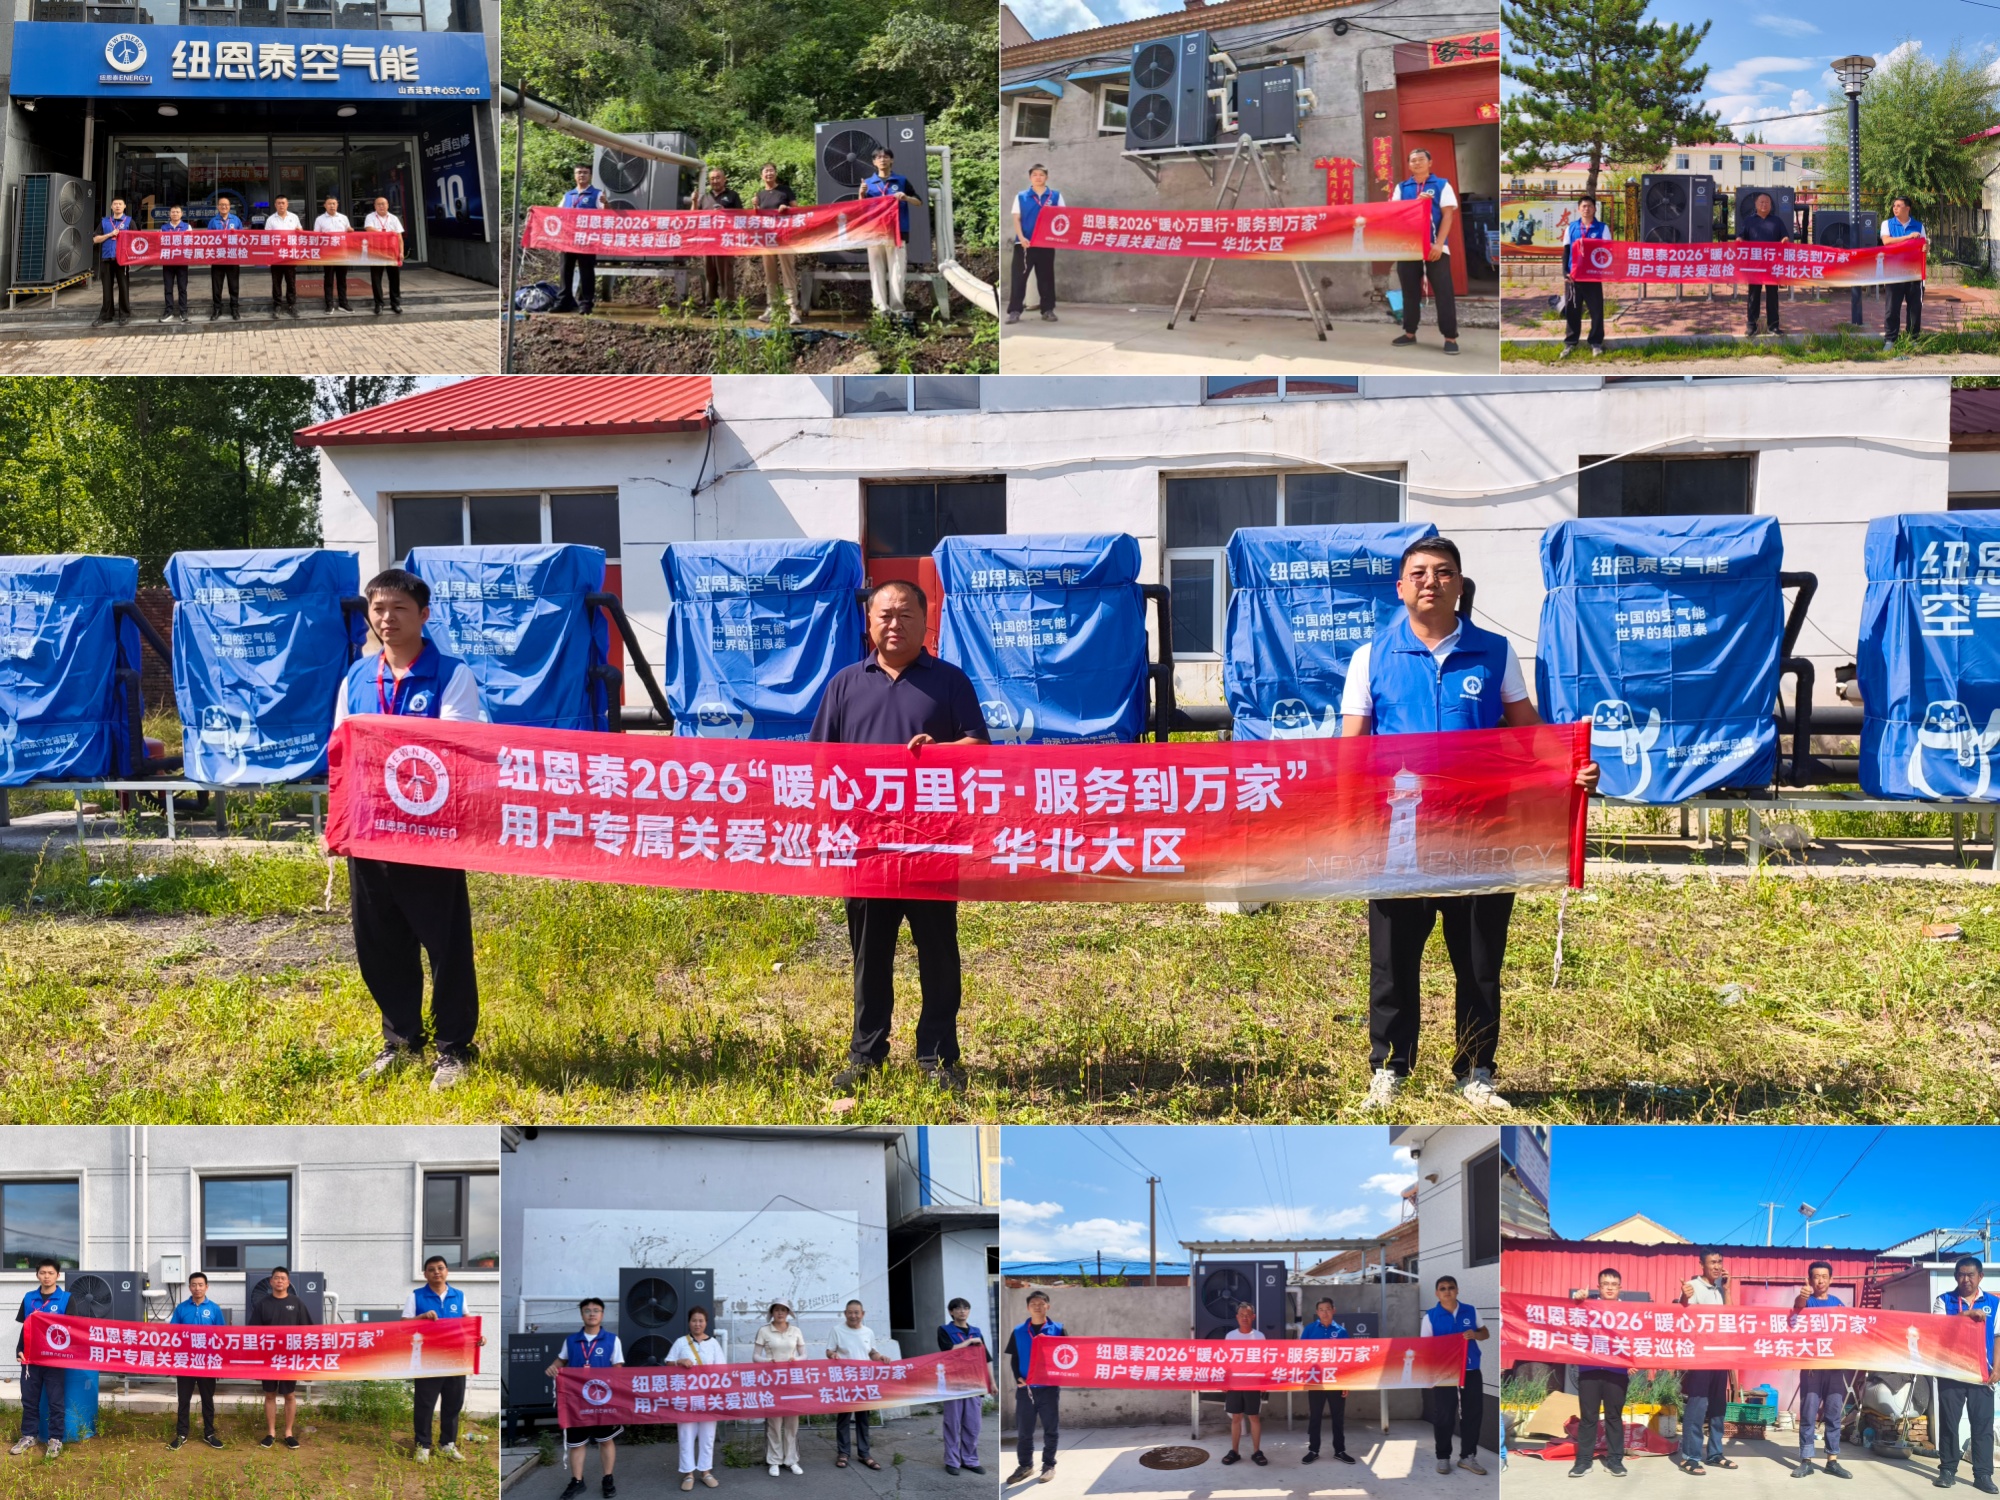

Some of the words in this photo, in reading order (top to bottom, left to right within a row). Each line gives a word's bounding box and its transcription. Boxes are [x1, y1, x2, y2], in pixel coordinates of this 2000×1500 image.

[171, 40, 420, 82] 纽恩泰空气能
[1269, 557, 1393, 581] 纽恩泰空气能
[1590, 556, 1729, 577] 纽恩泰空气能
[695, 573, 801, 593] 纽恩泰空气能
[970, 568, 1081, 589] 纽恩泰空气能
[193, 587, 288, 605] 纽恩泰空气能
[433, 581, 535, 601] 纽恩泰空气能
[991, 617, 1067, 632] 中国的空气能
[1292, 610, 1376, 627] 中国的空气能
[1615, 606, 1706, 625] 中国的空气能
[713, 623, 785, 637] 中国的空气能
[1293, 625, 1377, 643] 世界的纽恩泰
[1615, 622, 1708, 641] 世界的纽恩泰
[713, 638, 787, 651] 世界的纽恩泰
[992, 632, 1068, 648] 世界的纽恩泰
[496, 745, 1307, 814] 纽恩泰2026“暖心万里行·服务到万家”
[1428, 843, 1556, 876] ENERGY
